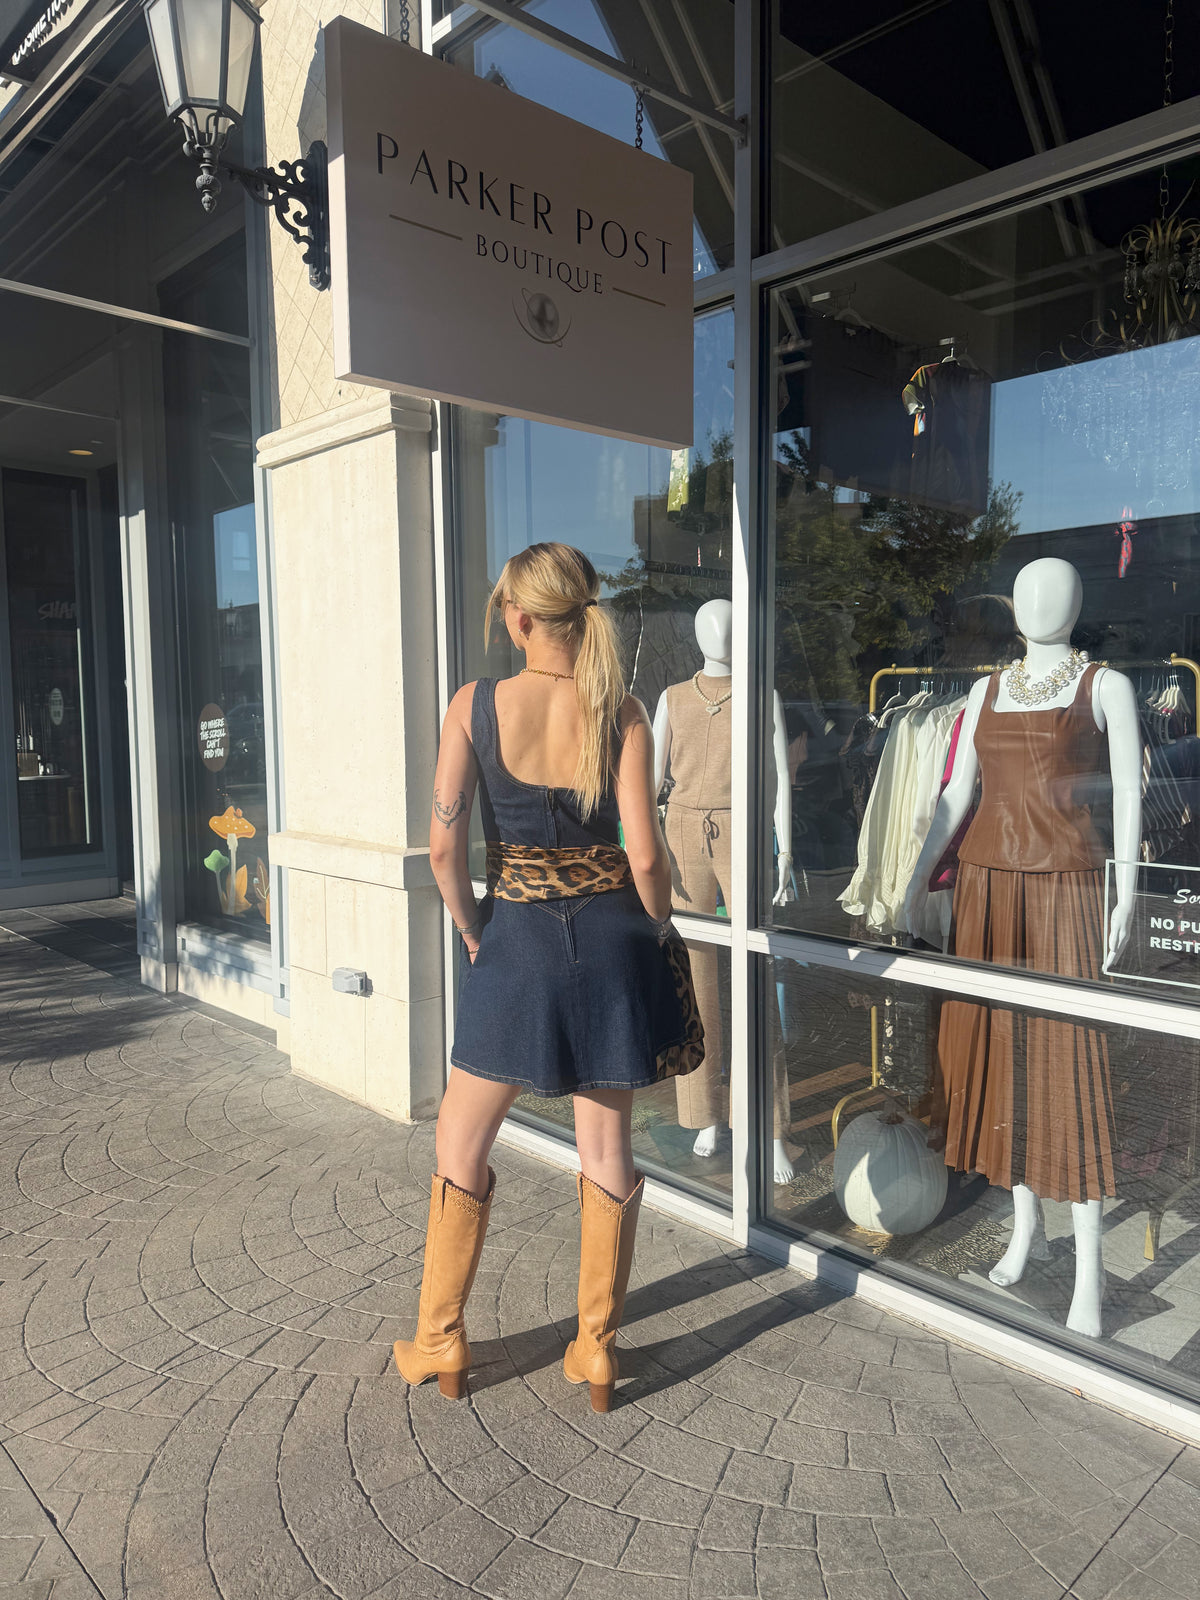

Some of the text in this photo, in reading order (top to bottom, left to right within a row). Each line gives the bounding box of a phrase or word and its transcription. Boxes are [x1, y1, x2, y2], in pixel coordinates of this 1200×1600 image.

[377, 132, 673, 274] PARKER POST
[476, 234, 602, 294] BOUTIQUE
[200, 718, 224, 730] GO WHERE
[200, 728, 226, 741] THE SCROLL
[215, 748, 224, 758] YOU
[1150, 917, 1175, 931] NO
